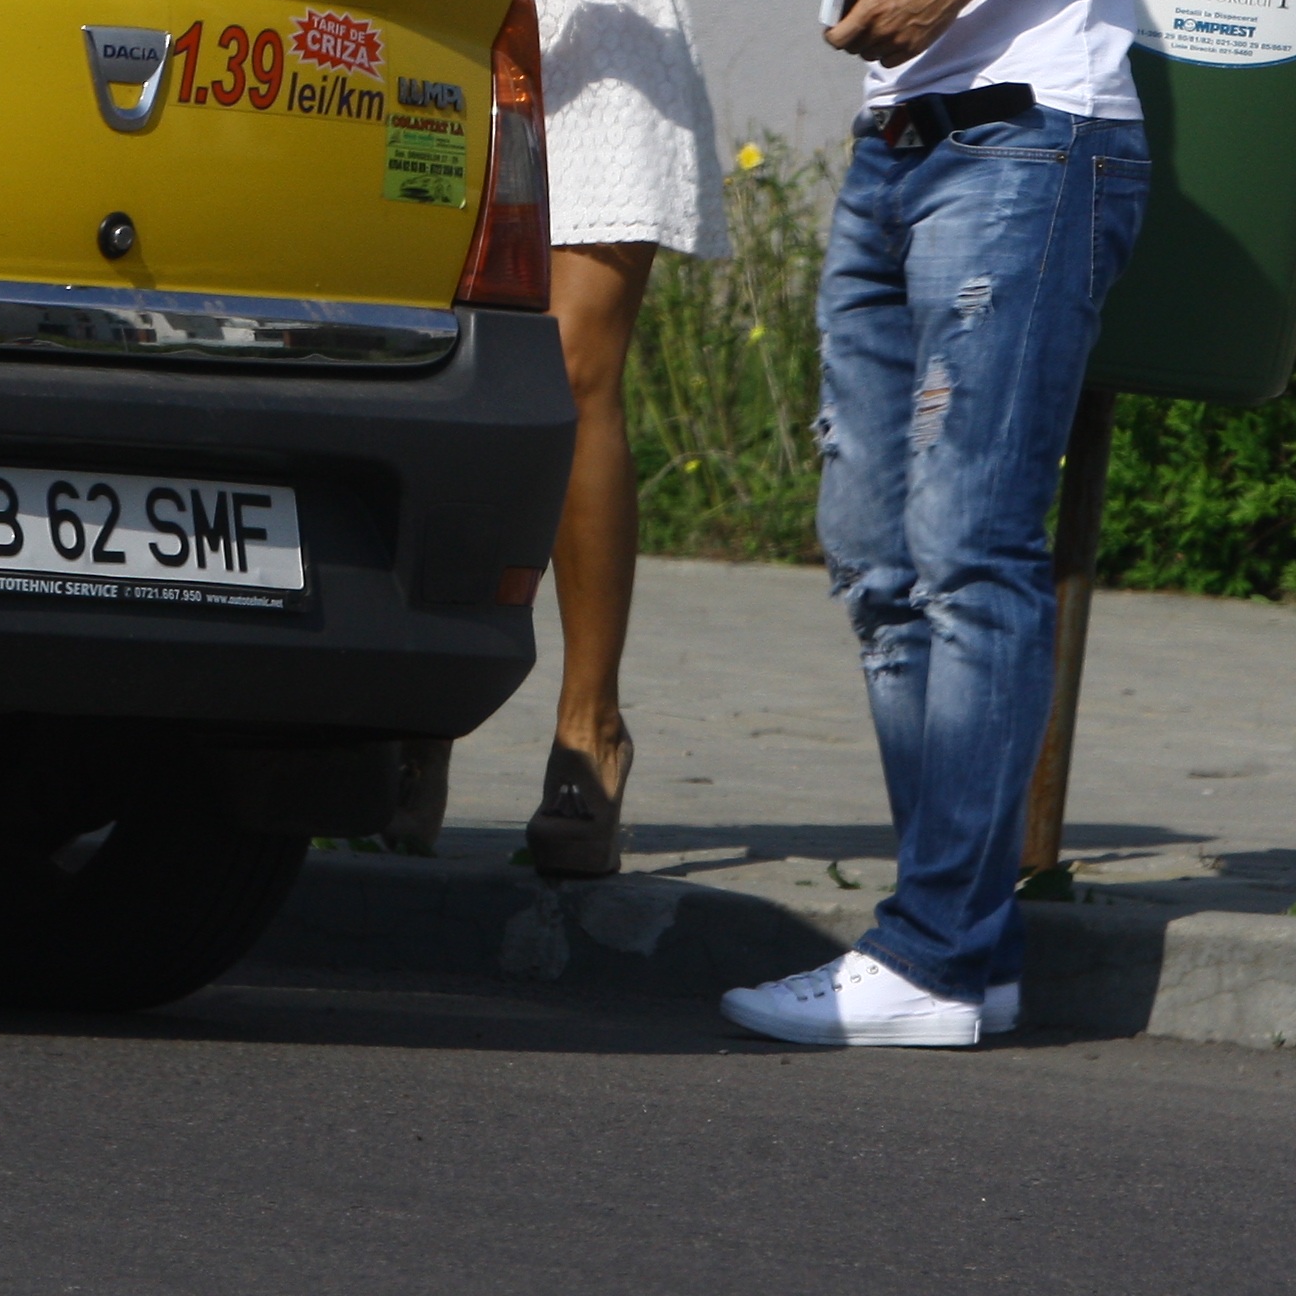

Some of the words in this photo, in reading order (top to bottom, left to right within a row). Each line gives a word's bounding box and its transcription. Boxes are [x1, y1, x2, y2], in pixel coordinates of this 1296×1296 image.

[312, 15, 347, 36] TARIF
[350, 28, 366, 43] DE
[1173, 18, 1256, 38] ROMPREST
[103, 44, 160, 62] DACIA
[306, 29, 369, 67] CRIZA
[174, 20, 284, 110] 1.39
[287, 72, 384, 121] lei/km
[46, 480, 126, 564] 62
[145, 486, 272, 573] SMF
[65, 581, 119, 598] SERVICE
